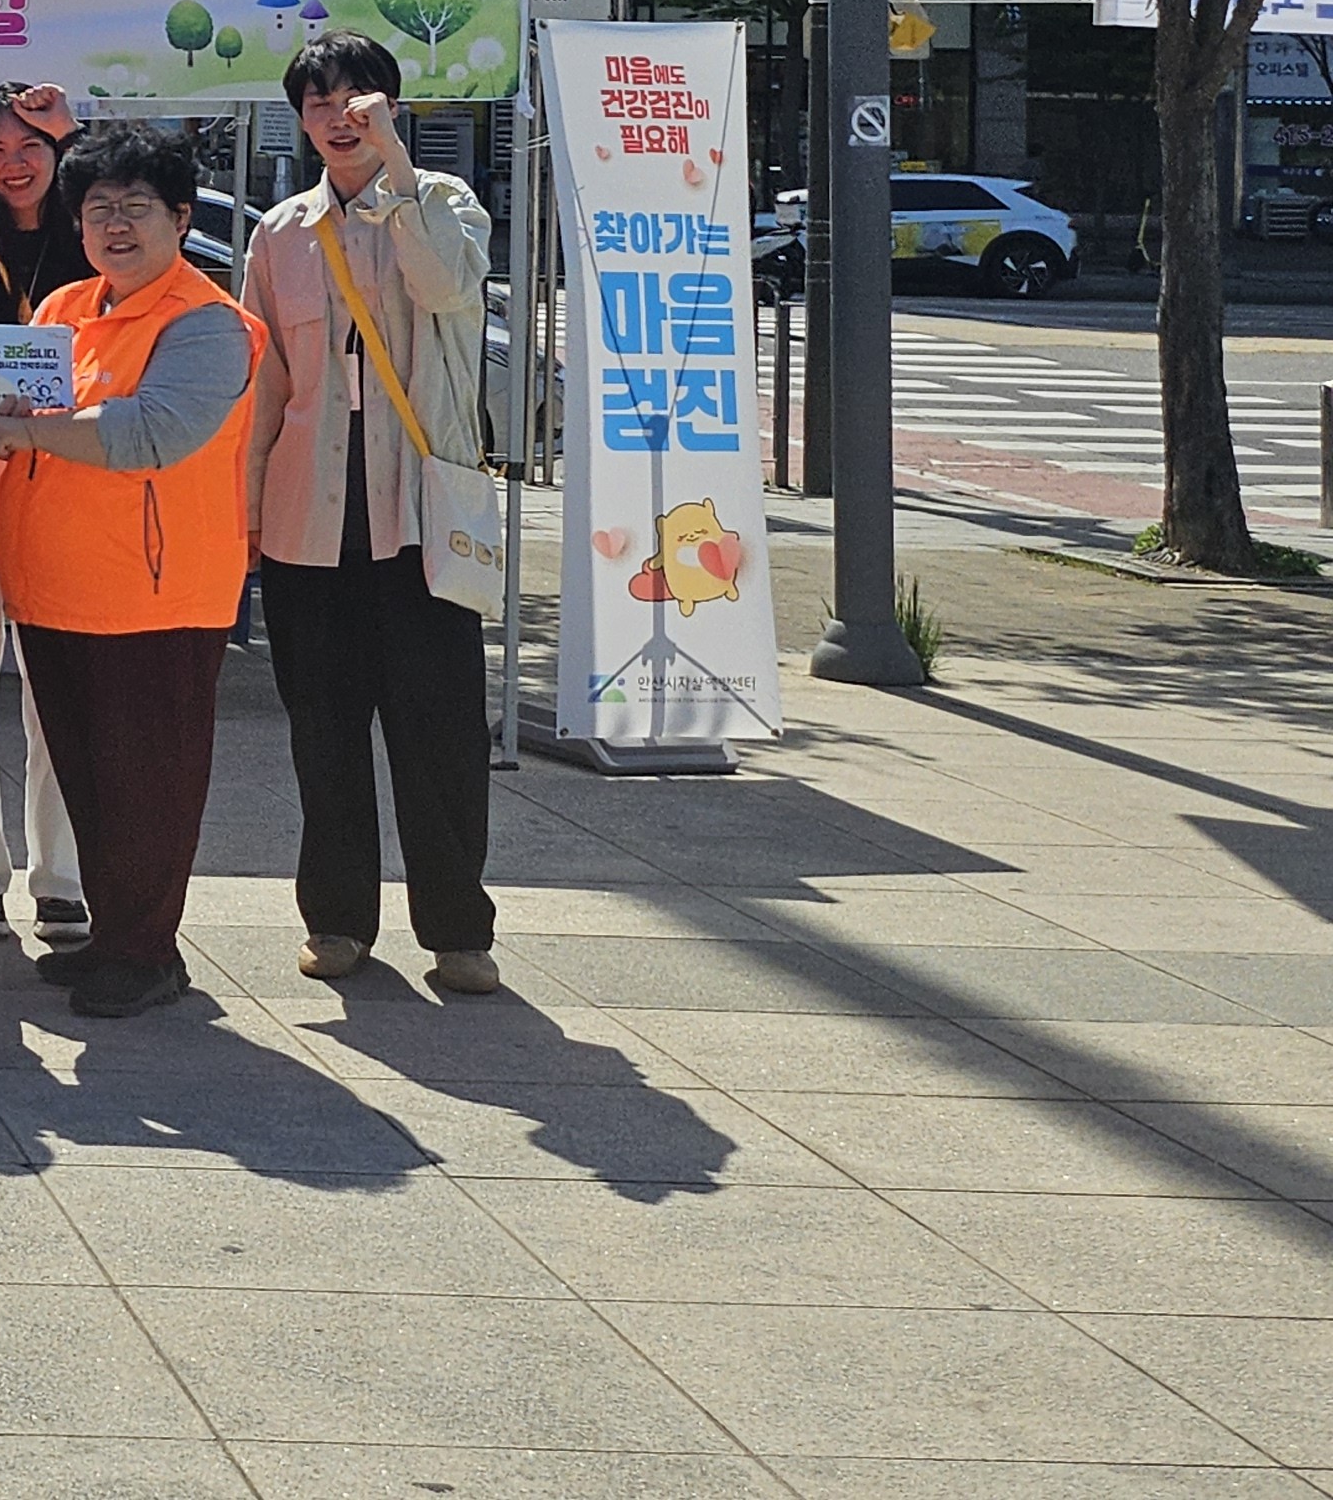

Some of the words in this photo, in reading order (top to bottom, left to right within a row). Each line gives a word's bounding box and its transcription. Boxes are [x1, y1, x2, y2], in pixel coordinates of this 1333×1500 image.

[604, 55, 687, 86] 마음에도
[599, 88, 711, 121] 건강검진이
[619, 125, 691, 156] 필요해
[593, 210, 731, 256] 찾아가는
[600, 271, 736, 357] 마음
[602, 368, 741, 453] 검진
